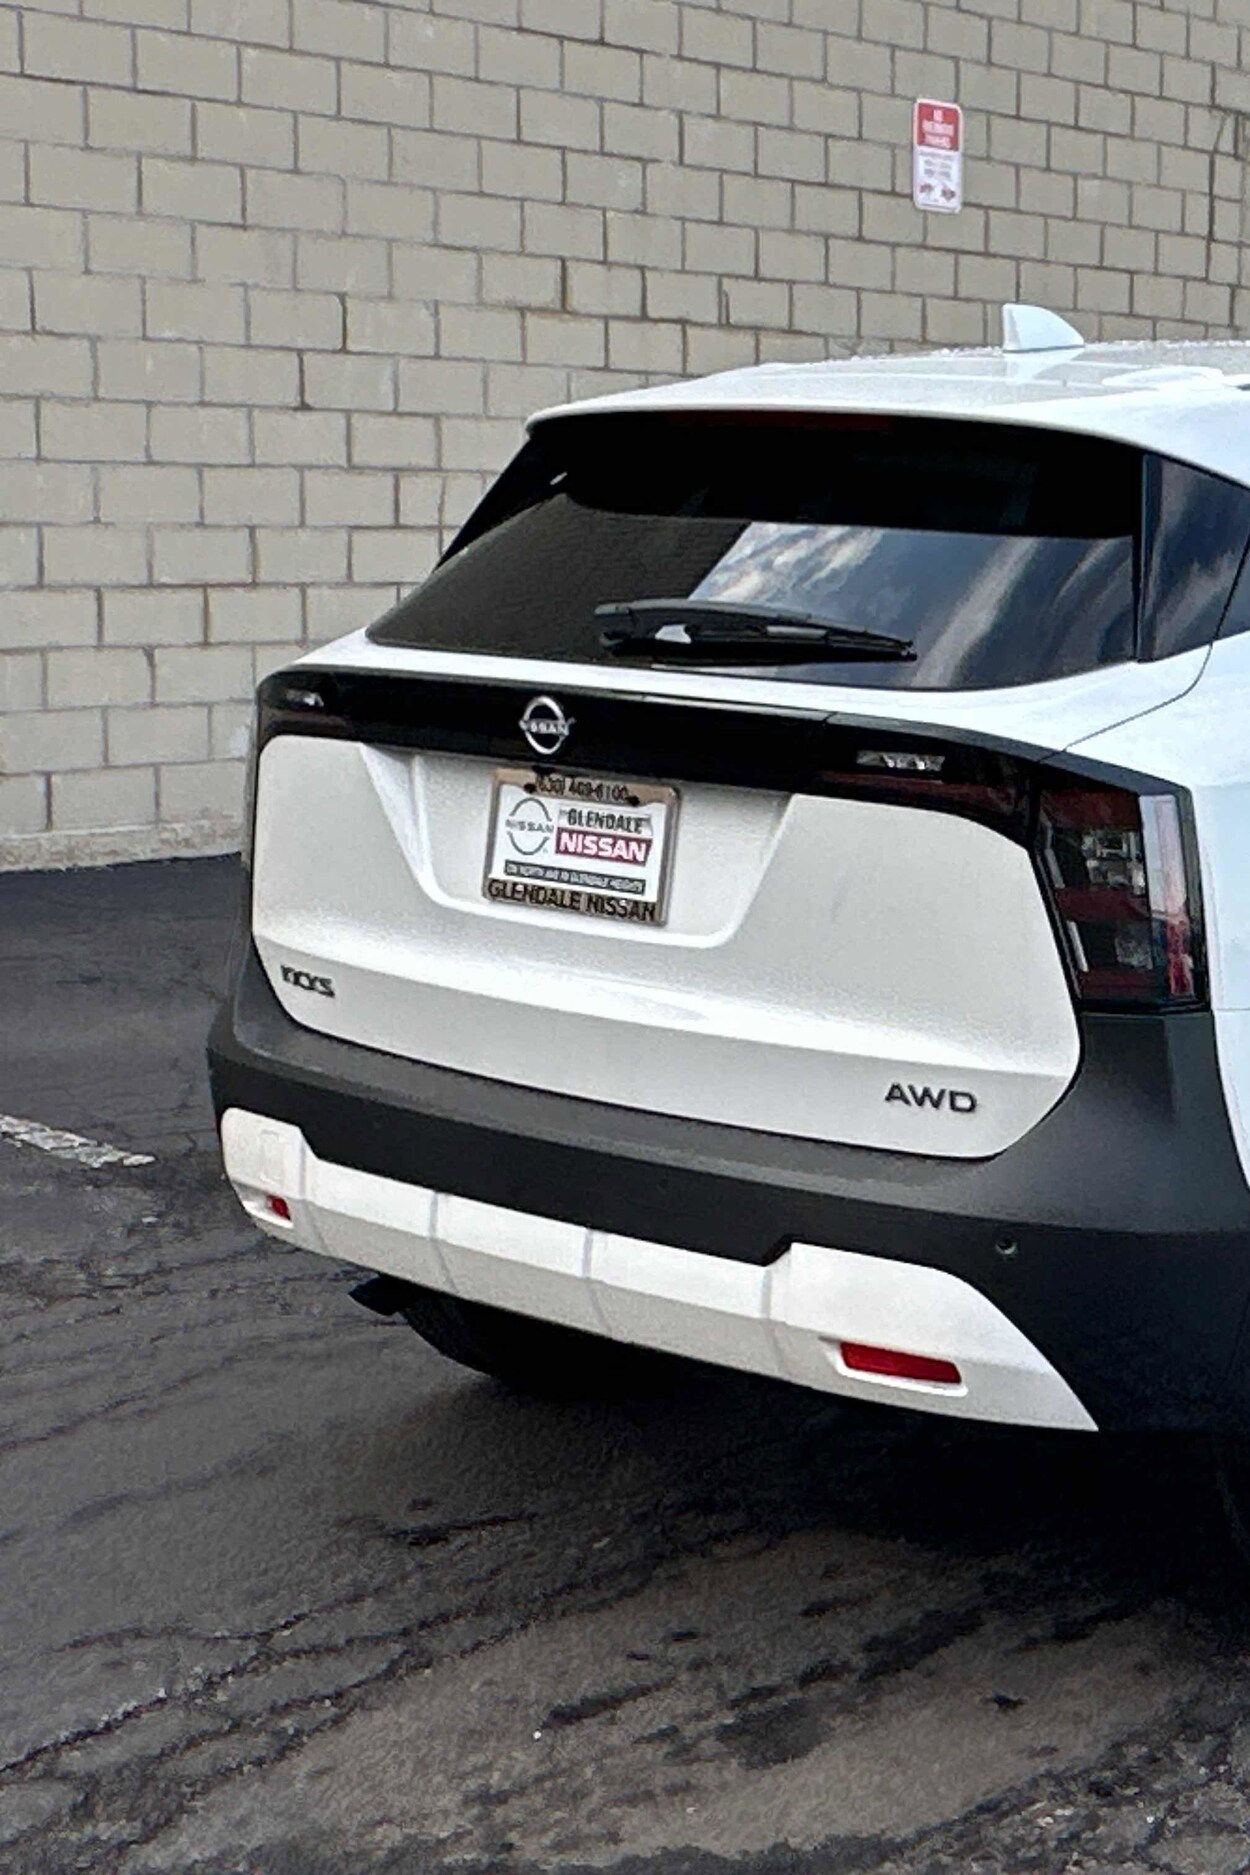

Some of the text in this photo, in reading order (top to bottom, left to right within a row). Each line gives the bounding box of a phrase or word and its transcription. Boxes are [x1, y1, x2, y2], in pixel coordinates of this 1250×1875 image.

[505, 819, 554, 833] NISSAN
[567, 808, 644, 833] GLENDALE
[559, 832, 647, 862] NISSAN
[488, 880, 657, 922] GLENDALE NISSAN
[884, 1082, 978, 1113] AWD
